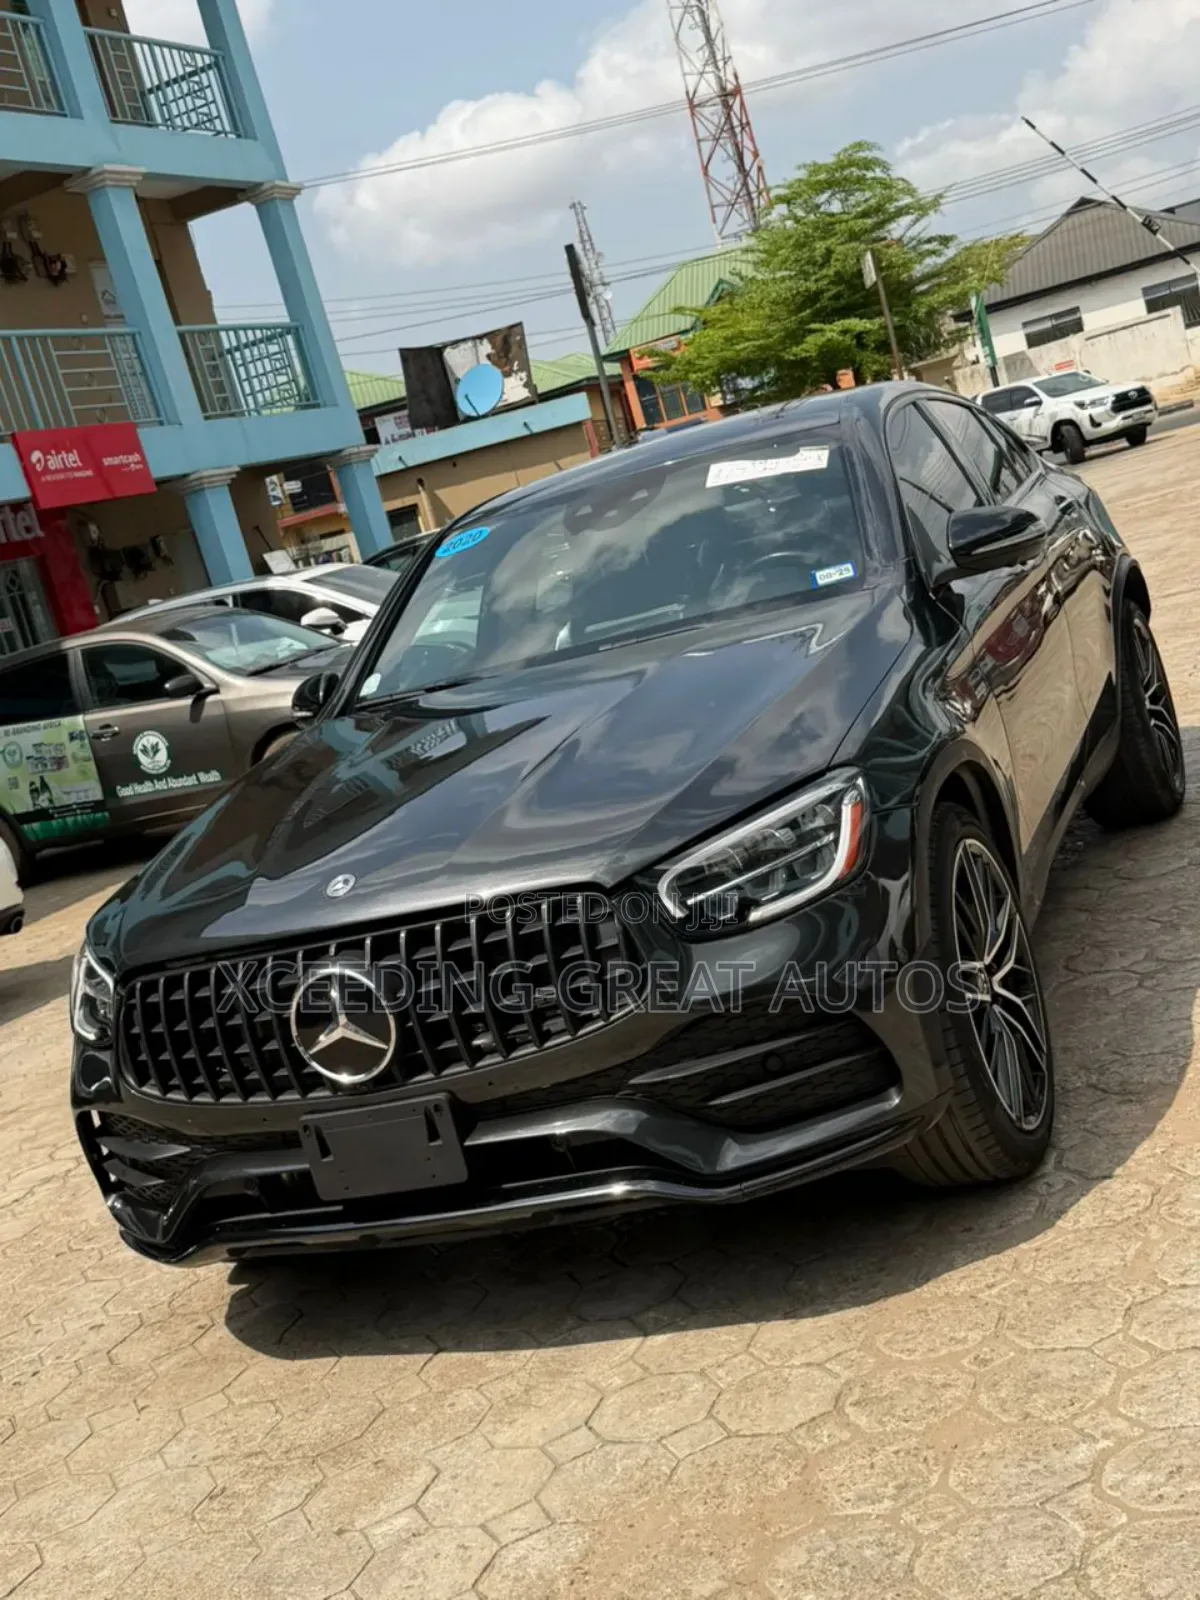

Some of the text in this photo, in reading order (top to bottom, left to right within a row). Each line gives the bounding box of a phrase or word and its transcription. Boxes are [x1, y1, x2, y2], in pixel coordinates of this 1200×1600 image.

[46, 449, 83, 471] airtel
[440, 529, 484, 555] 2020
[116, 769, 221, 798] Good Health And Abundant Wealth
